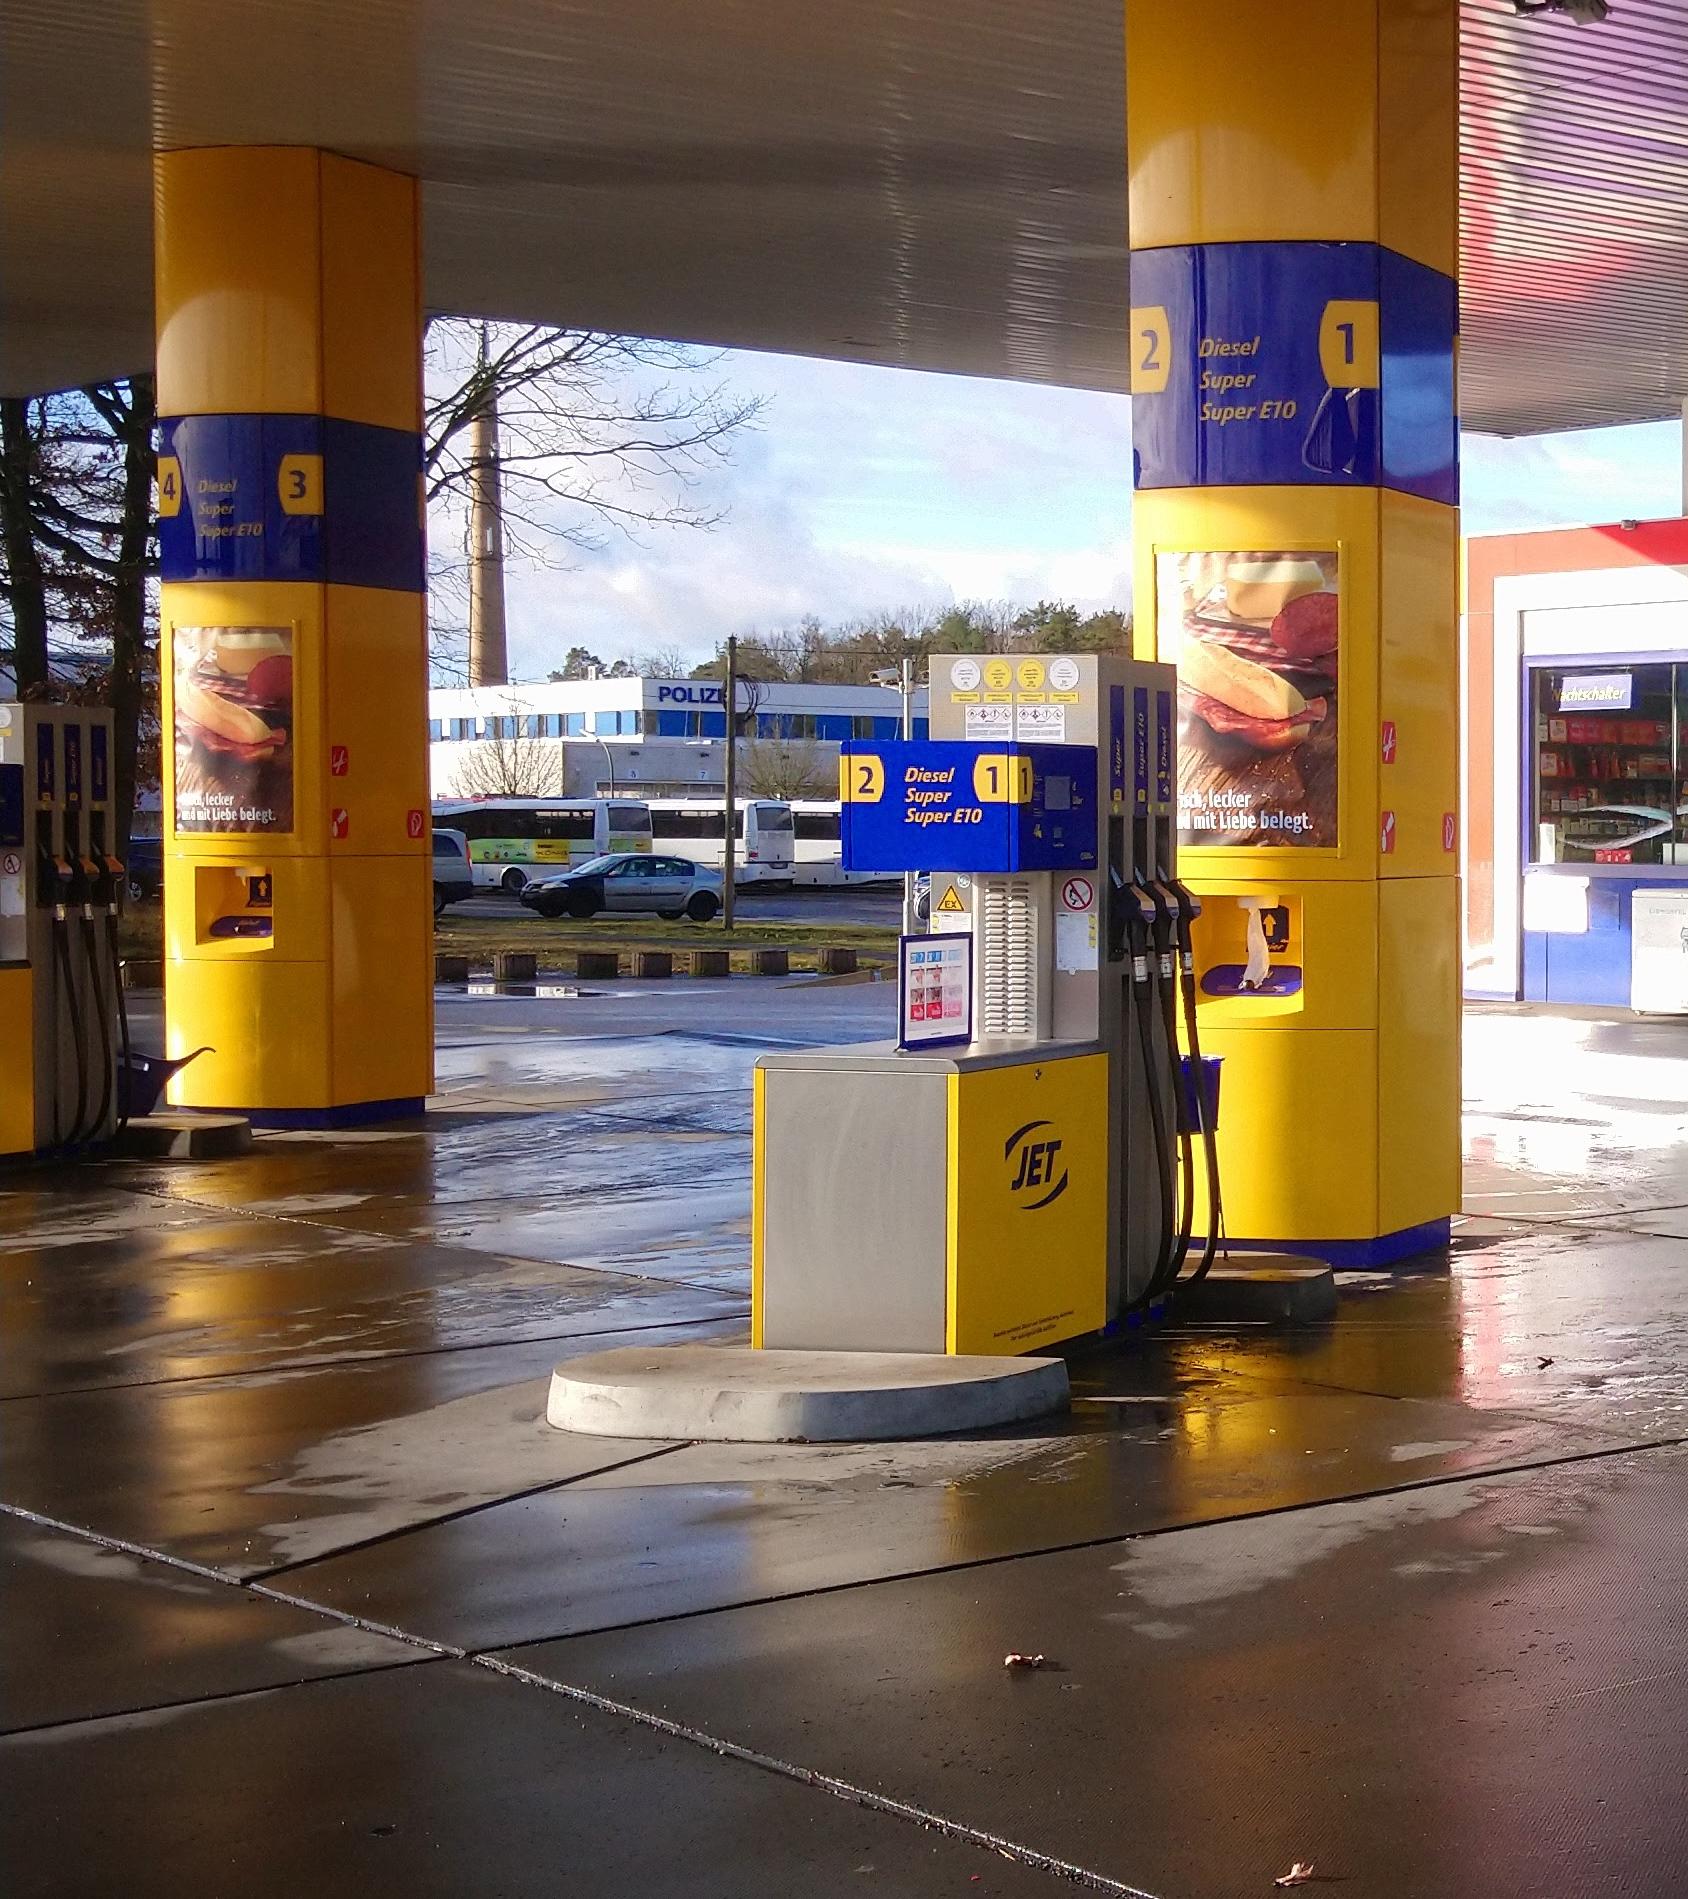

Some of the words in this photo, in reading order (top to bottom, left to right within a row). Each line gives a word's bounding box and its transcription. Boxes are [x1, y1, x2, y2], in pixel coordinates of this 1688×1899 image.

[1140, 329, 1161, 371] 2
[1199, 336, 1261, 358] Diesel
[1335, 323, 1355, 365] 1
[1200, 372, 1257, 395] Super
[1200, 402, 1256, 427] Super
[1259, 400, 1297, 421] E10
[163, 471, 176, 501] 4
[199, 479, 238, 494] Diesel
[287, 470, 307, 499] 3
[200, 502, 235, 518] Super
[200, 523, 234, 541] Super
[237, 521, 264, 537] E10
[657, 686, 724, 704] POLIZ
[858, 766, 875, 794] 2
[904, 767, 956, 784] Diesel
[985, 766, 998, 794] 1
[1020, 767, 1029, 796] 1
[206, 792, 234, 807] lecker
[904, 788, 952, 807] Super
[1208, 788, 1252, 808] lecker
[212, 808, 238, 821] Liebe
[239, 807, 276, 823] belegt.
[904, 808, 952, 828] Super
[953, 808, 983, 824] E10
[1193, 811, 1217, 830] mit
[1219, 810, 1257, 830] Liebe
[1260, 810, 1313, 834] belegt.
[944, 900, 957, 909] EX
[1010, 1139, 1063, 1191] JET
